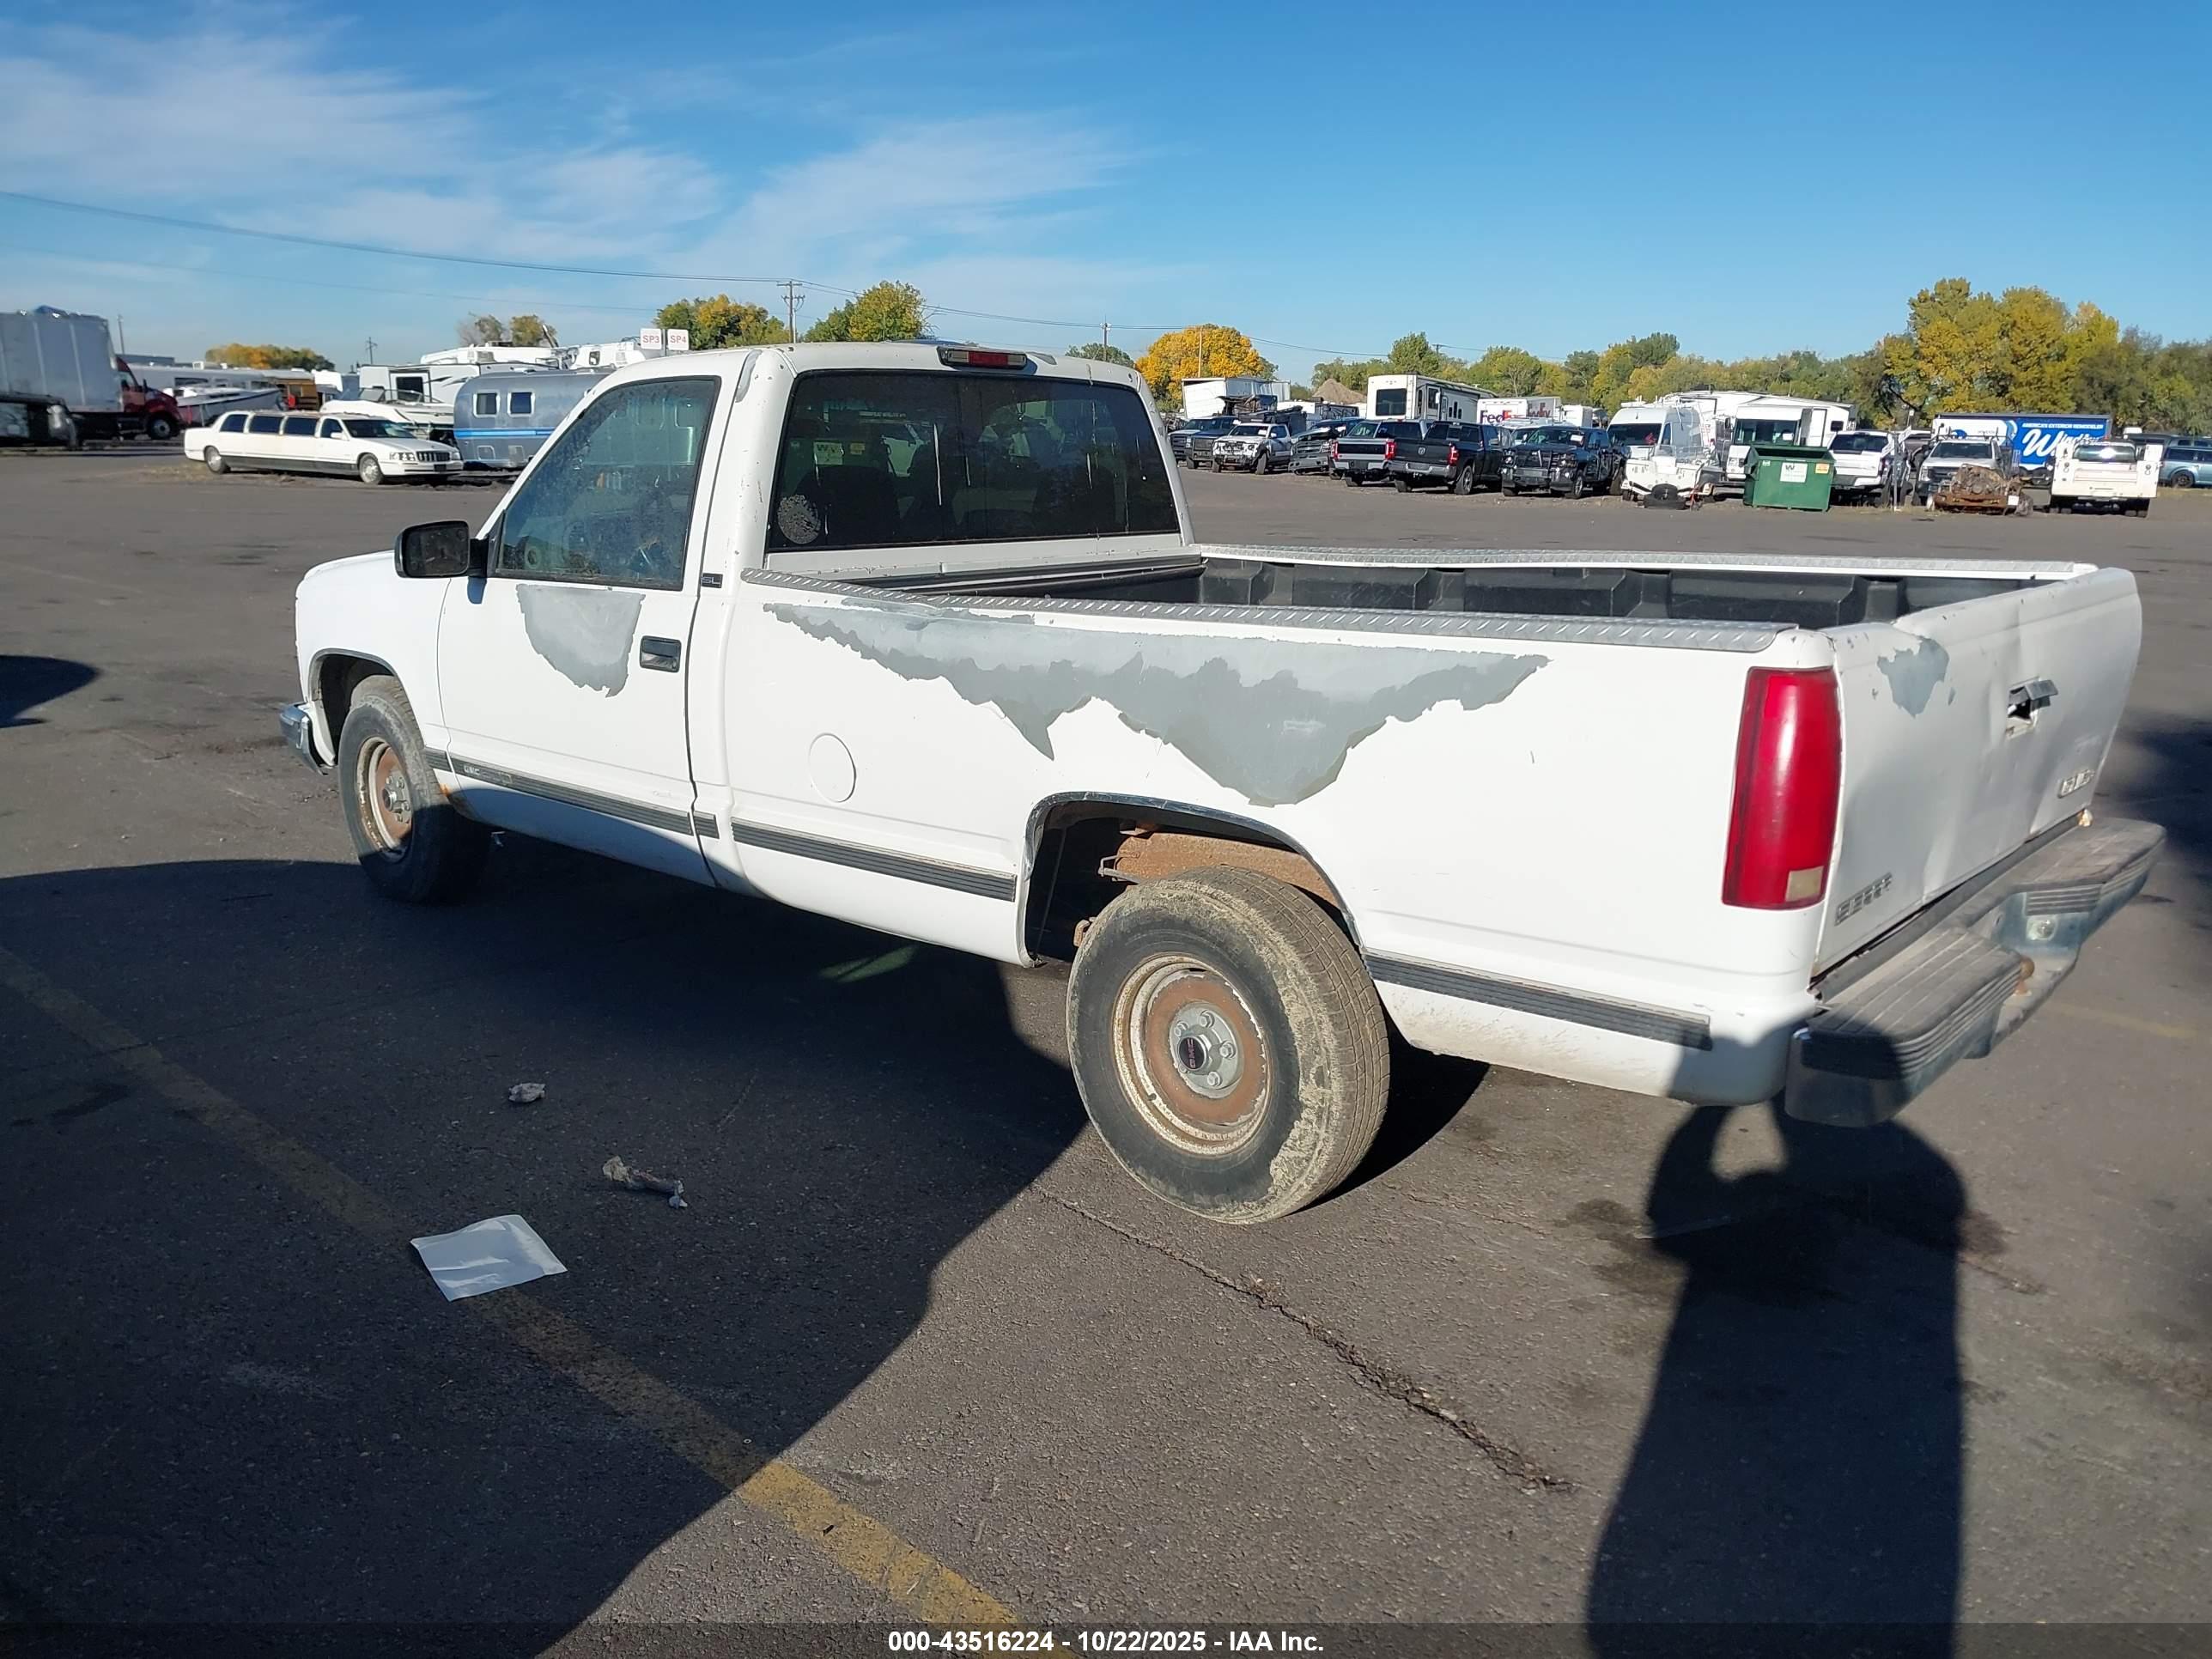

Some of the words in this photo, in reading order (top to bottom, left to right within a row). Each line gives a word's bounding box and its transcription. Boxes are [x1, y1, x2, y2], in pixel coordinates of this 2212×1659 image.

[642, 335, 659, 343] SP3
[670, 335, 687, 343] SP4
[1480, 410, 1516, 424] FedE
[1187, 1038, 1196, 1068] GMC
